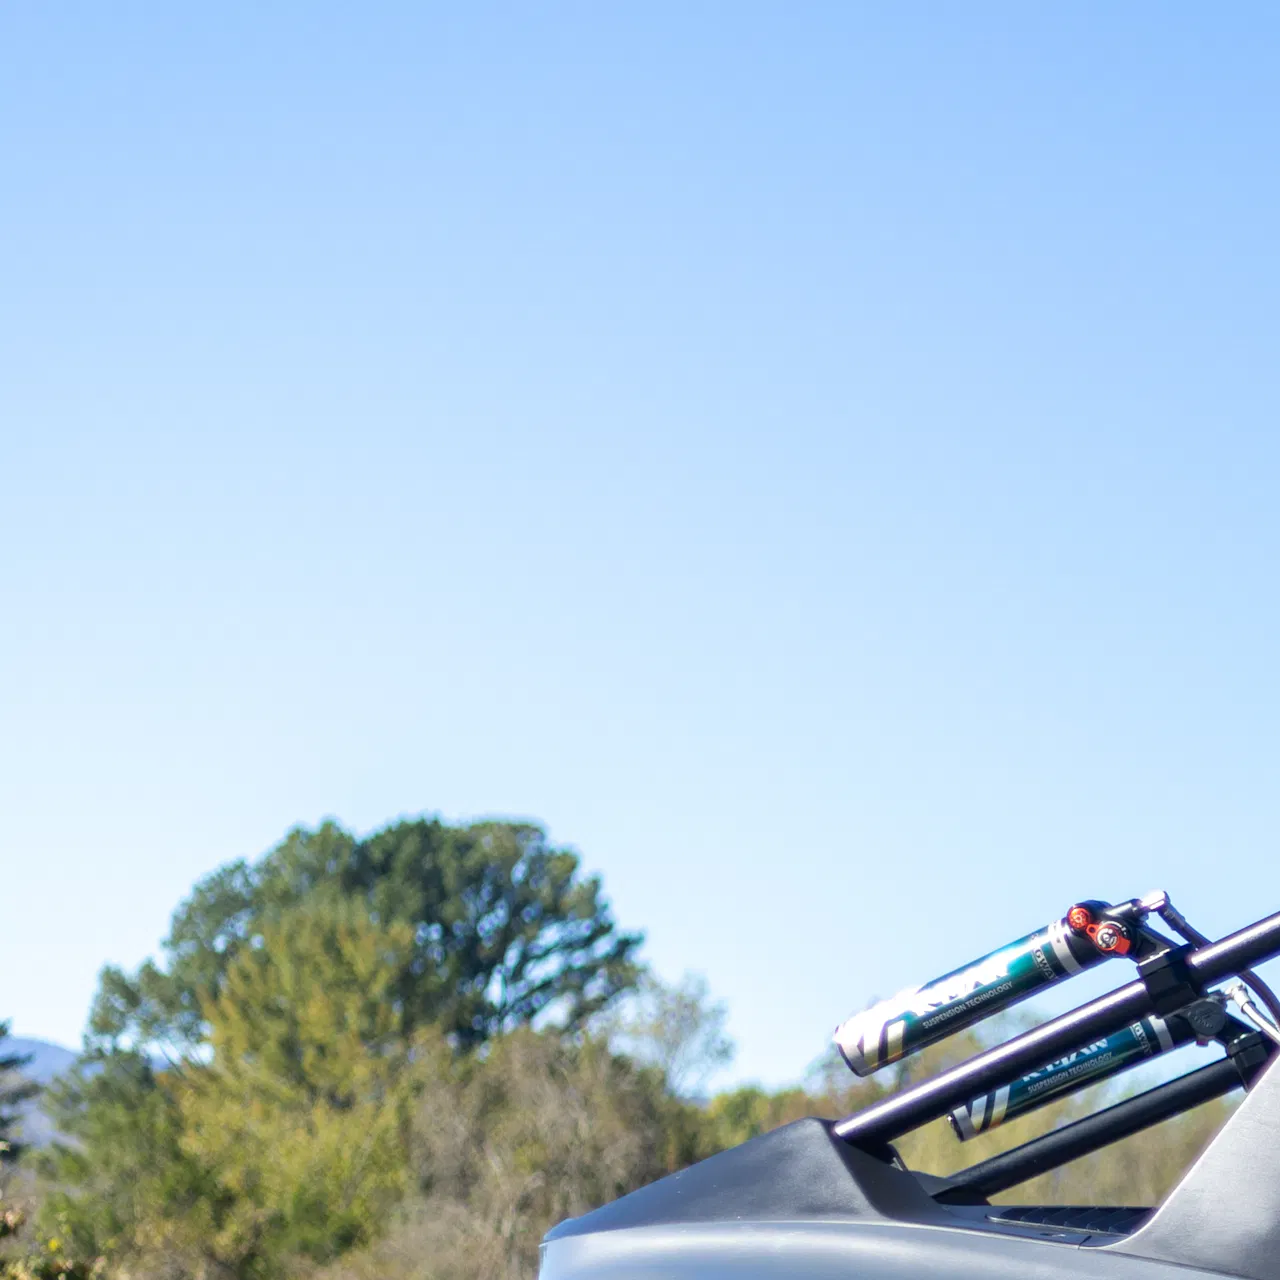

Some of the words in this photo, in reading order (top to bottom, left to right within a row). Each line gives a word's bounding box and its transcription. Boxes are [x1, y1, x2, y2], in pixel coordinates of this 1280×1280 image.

[922, 1002, 967, 1029] SUSPENSION
[965, 980, 1013, 1008] TECHNOLOGY
[1026, 1069, 1070, 1094] SUSPENSION
[1068, 1051, 1114, 1077] TECHNOLOGY
